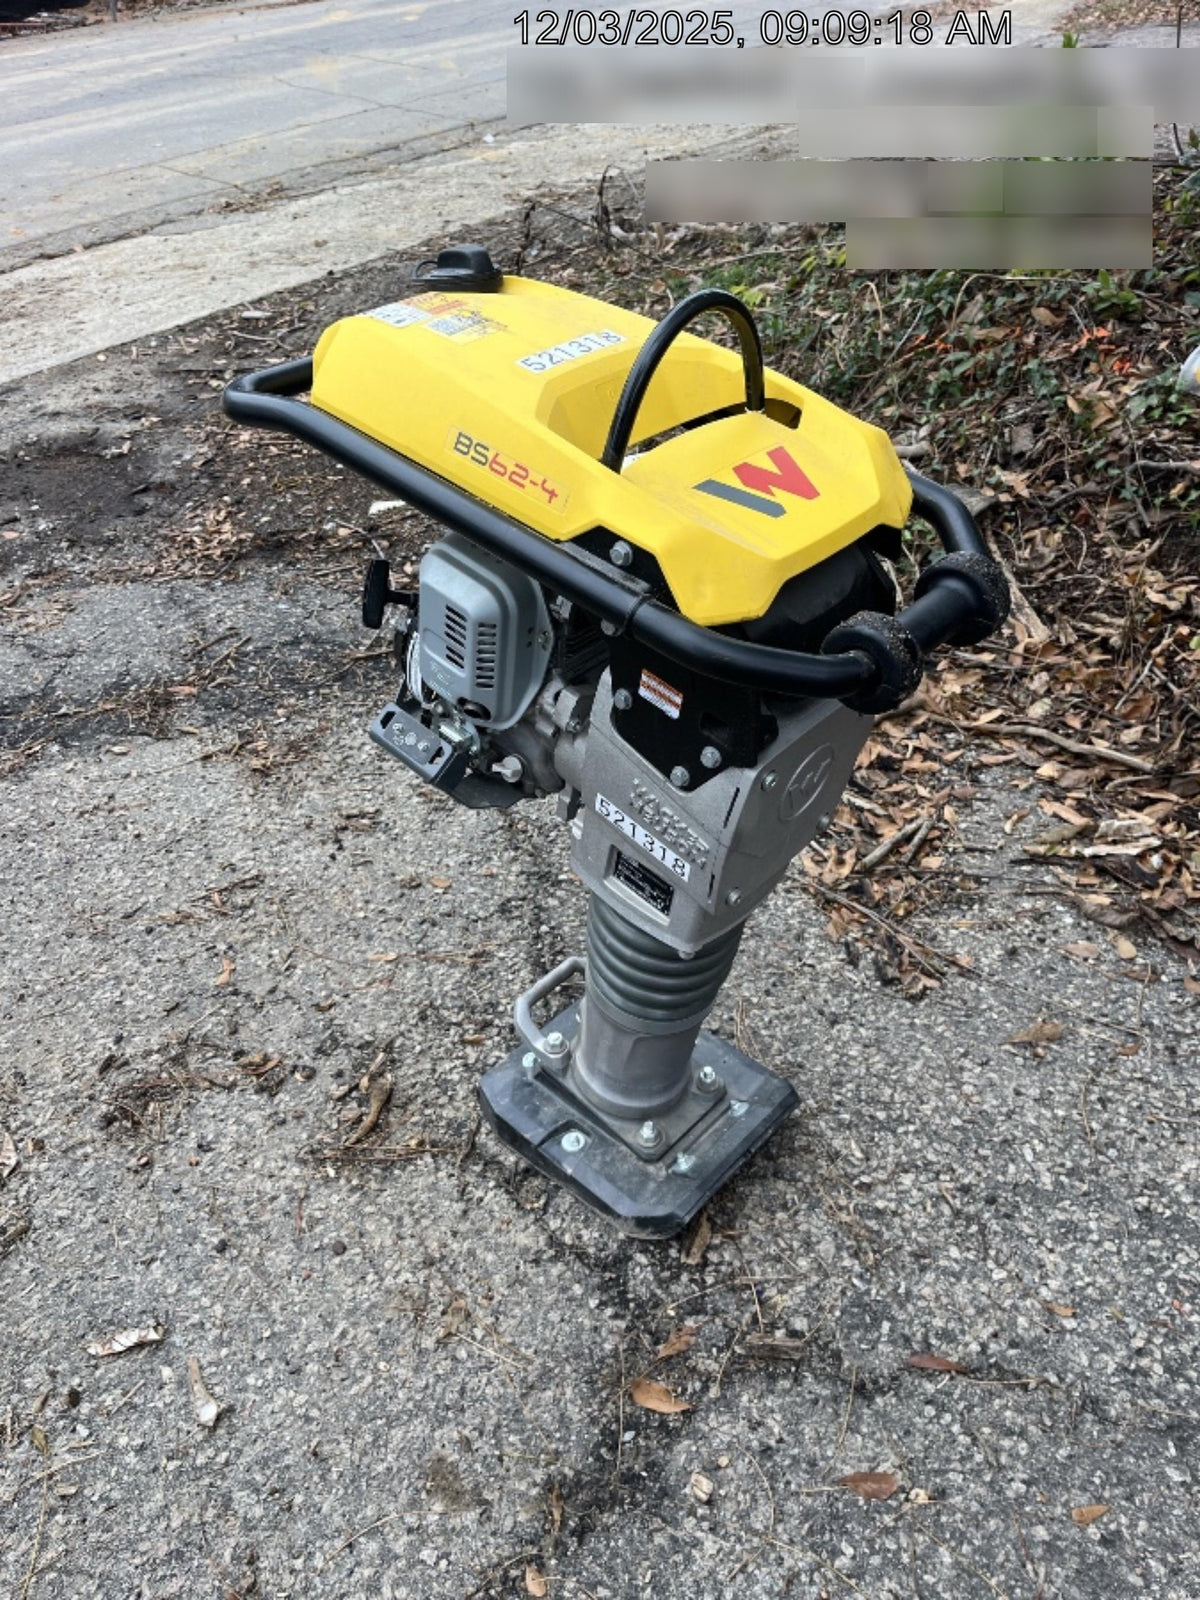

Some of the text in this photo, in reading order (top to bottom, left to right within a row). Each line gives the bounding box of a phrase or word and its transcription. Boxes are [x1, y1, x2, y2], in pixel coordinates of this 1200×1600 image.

[521, 329, 623, 372] 521318
[453, 431, 560, 504] BS62-4
[598, 797, 687, 878] 521318
